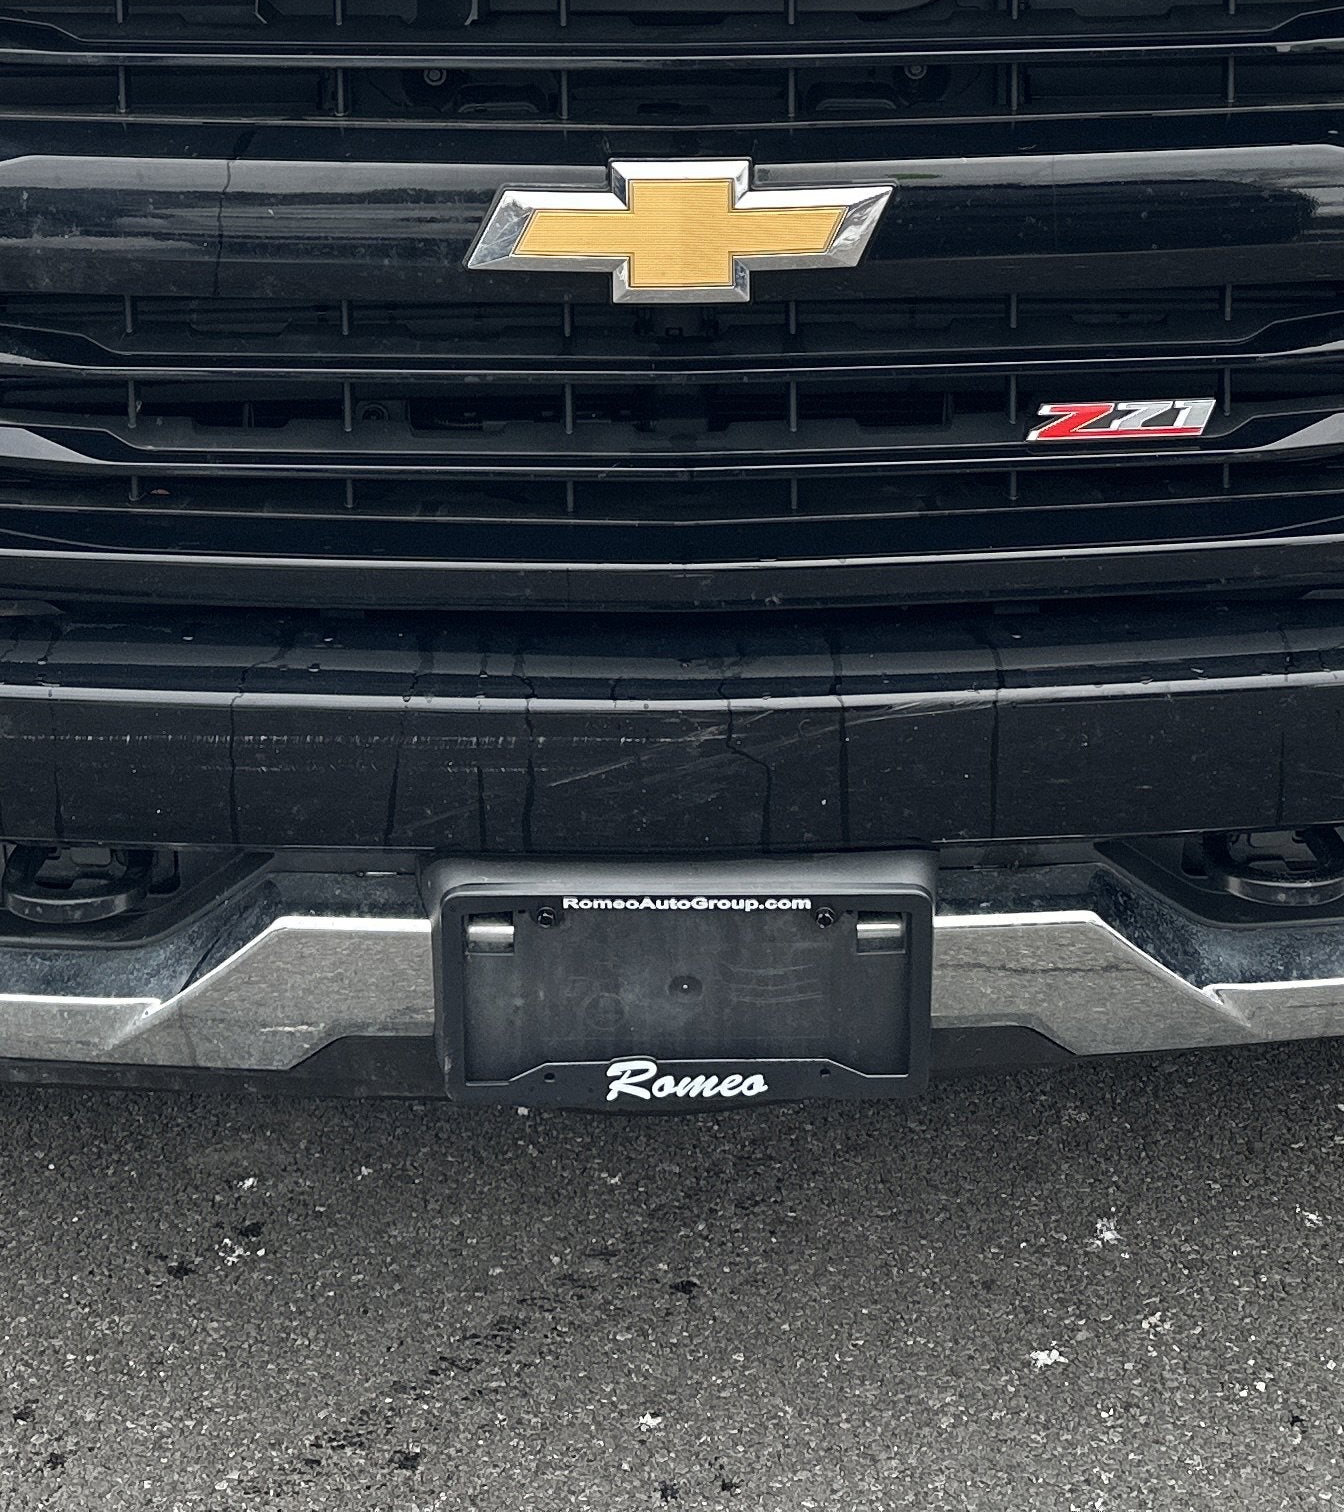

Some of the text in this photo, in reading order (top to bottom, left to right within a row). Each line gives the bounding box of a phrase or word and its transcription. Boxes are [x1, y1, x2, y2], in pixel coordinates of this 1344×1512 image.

[1026, 399, 1216, 440] Z71
[562, 896, 812, 912] RomeoAutoGroup.com
[606, 1060, 768, 1101] Romeo
